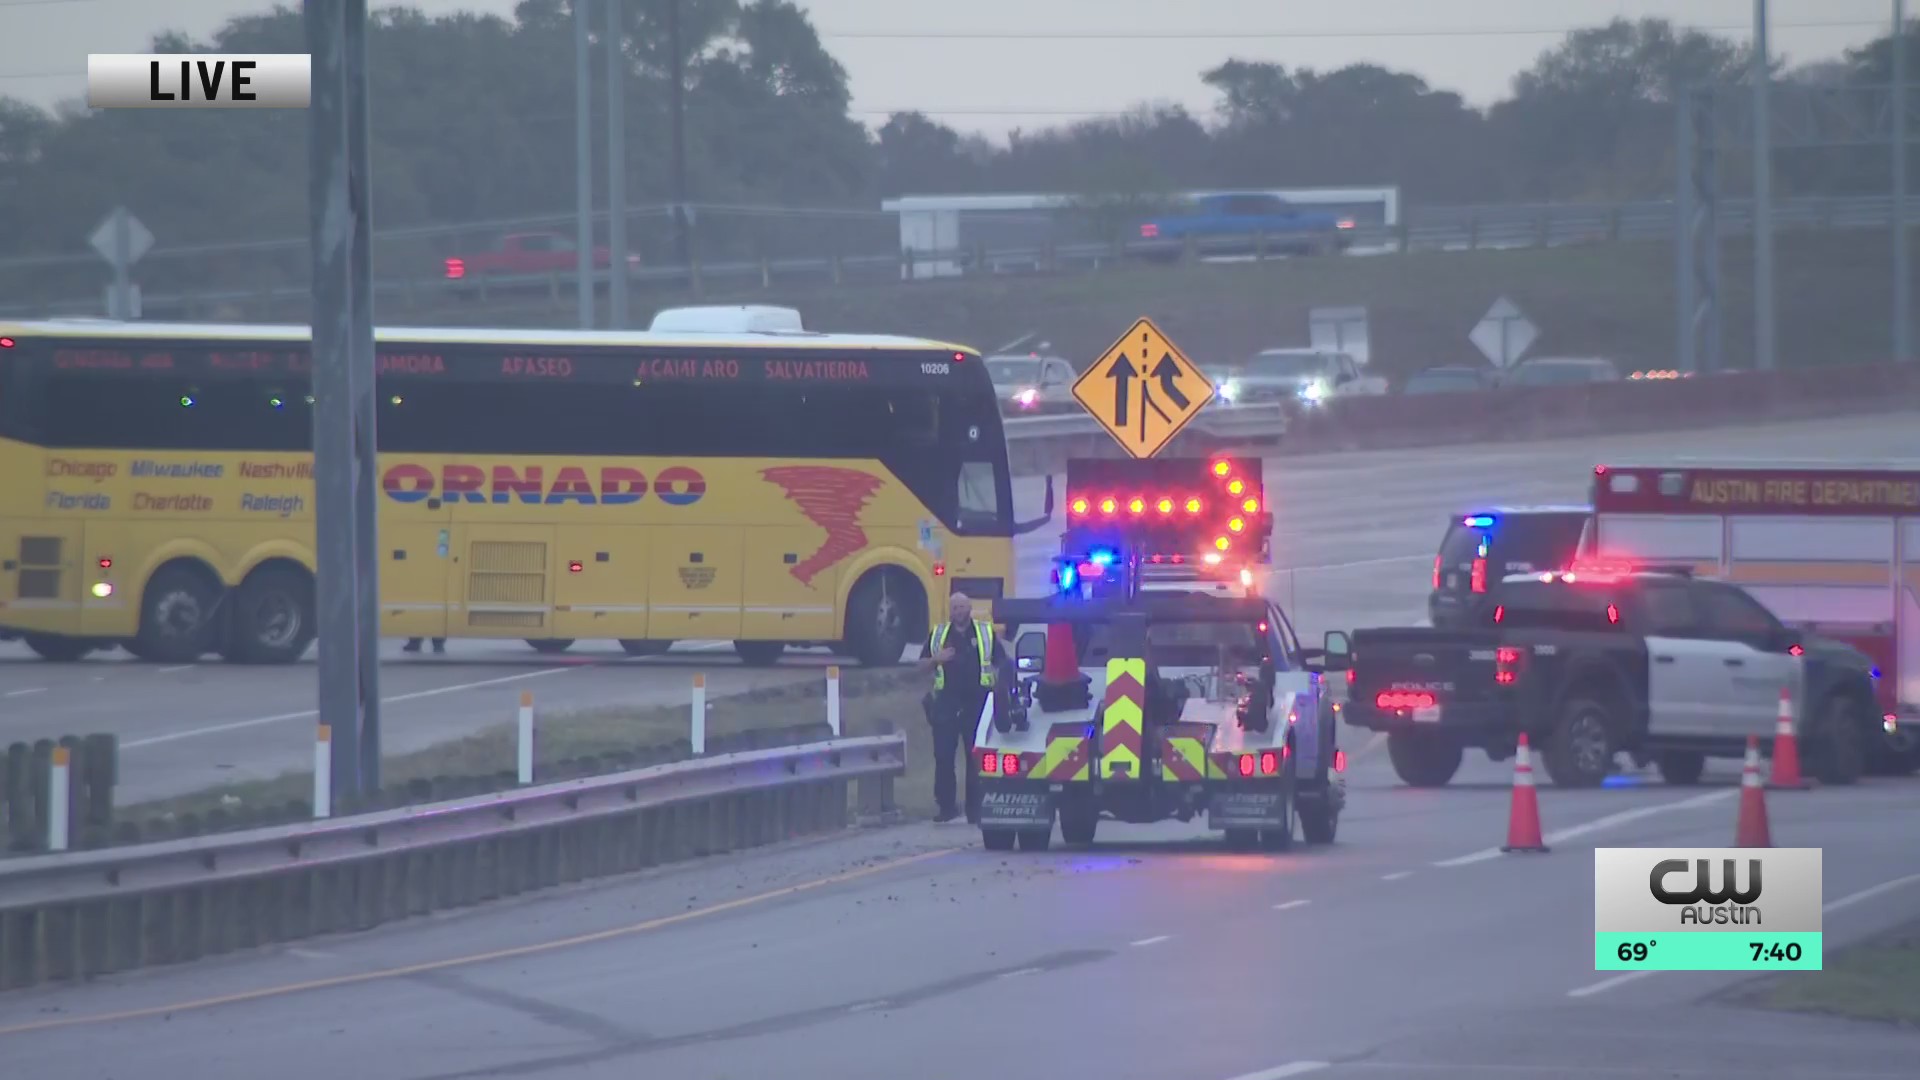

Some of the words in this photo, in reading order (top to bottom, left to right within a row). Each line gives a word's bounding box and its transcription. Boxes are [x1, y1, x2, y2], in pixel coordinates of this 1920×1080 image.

[378, 354, 446, 374] AMORA
[764, 359, 868, 379] SALVATIERRA
[920, 362, 949, 375] 10206
[48, 459, 117, 483] Chicago
[131, 460, 223, 479] Milwaukee
[382, 463, 707, 506] ORNADO
[1690, 479, 1757, 504] AUSTIN
[1764, 480, 1807, 505] FIRE
[45, 491, 111, 511] Florida
[133, 493, 213, 512] Charlotte
[241, 492, 304, 518] Raleigh
[1391, 682, 1456, 691] POLICE
